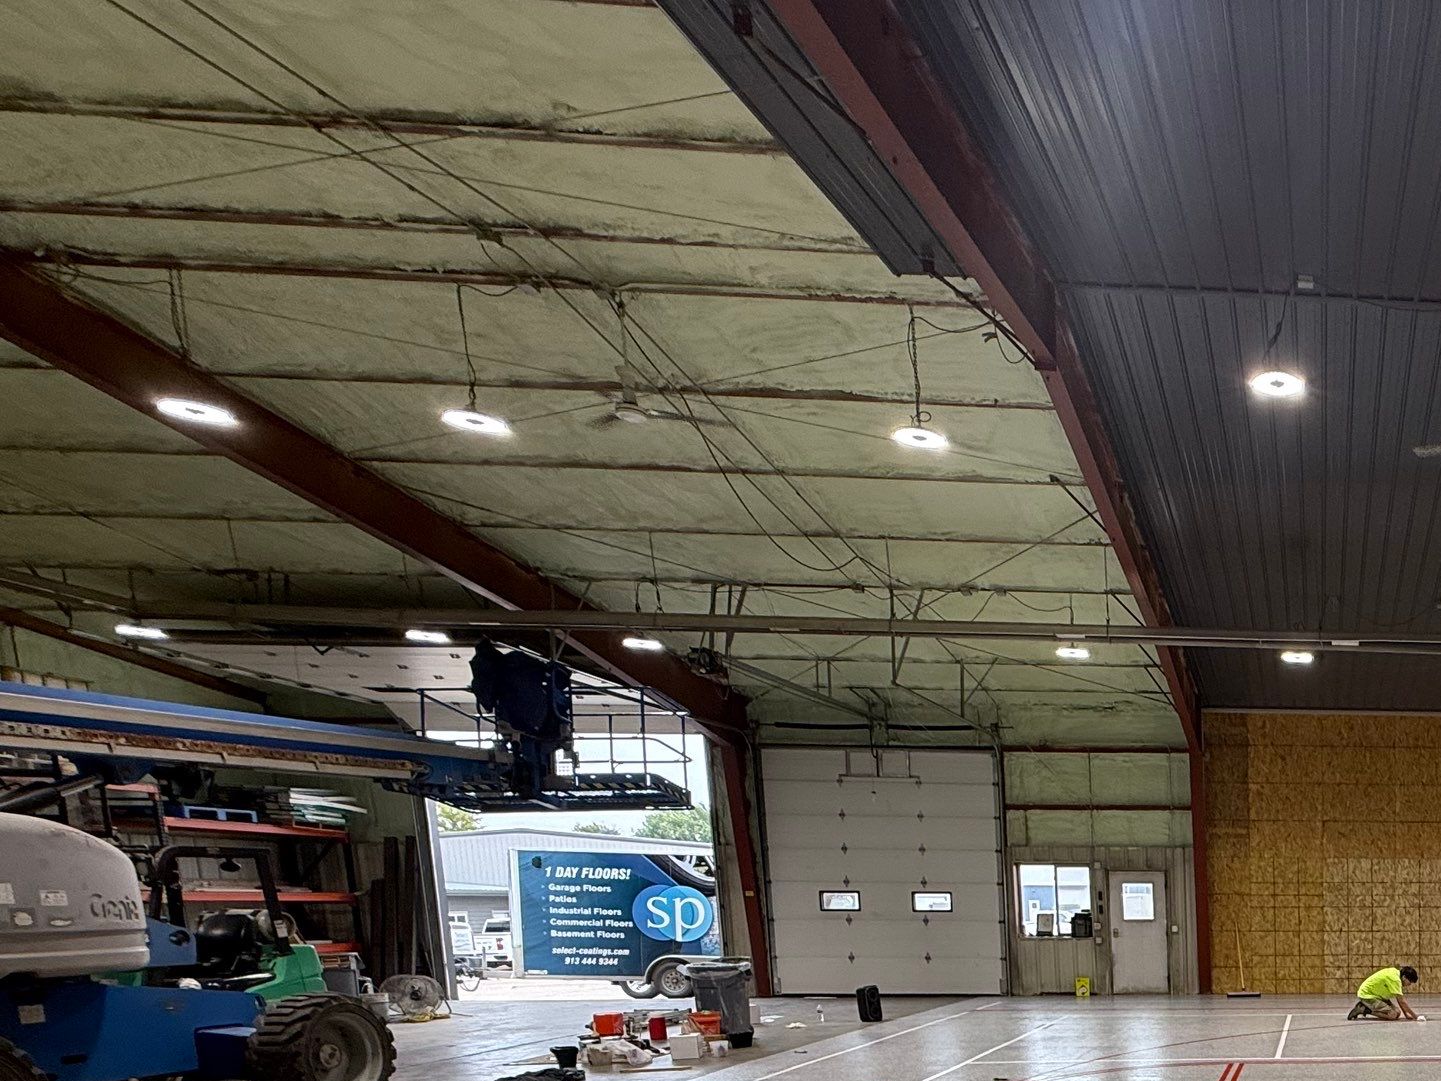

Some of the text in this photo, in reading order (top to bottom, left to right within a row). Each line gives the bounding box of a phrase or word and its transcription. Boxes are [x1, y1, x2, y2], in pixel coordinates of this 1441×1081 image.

[545, 866, 631, 880] 1 DAY FLOORS!
[548, 883, 612, 893] Garage Floors
[549, 894, 577, 903] Patios
[549, 906, 622, 916] Industrial Floors
[549, 918, 634, 928] Commercial Floors
[646, 895, 705, 942] sp
[550, 929, 625, 939] Basement Floors
[552, 946, 630, 957] select-coatings.com
[564, 956, 619, 966] 913 444 9344
